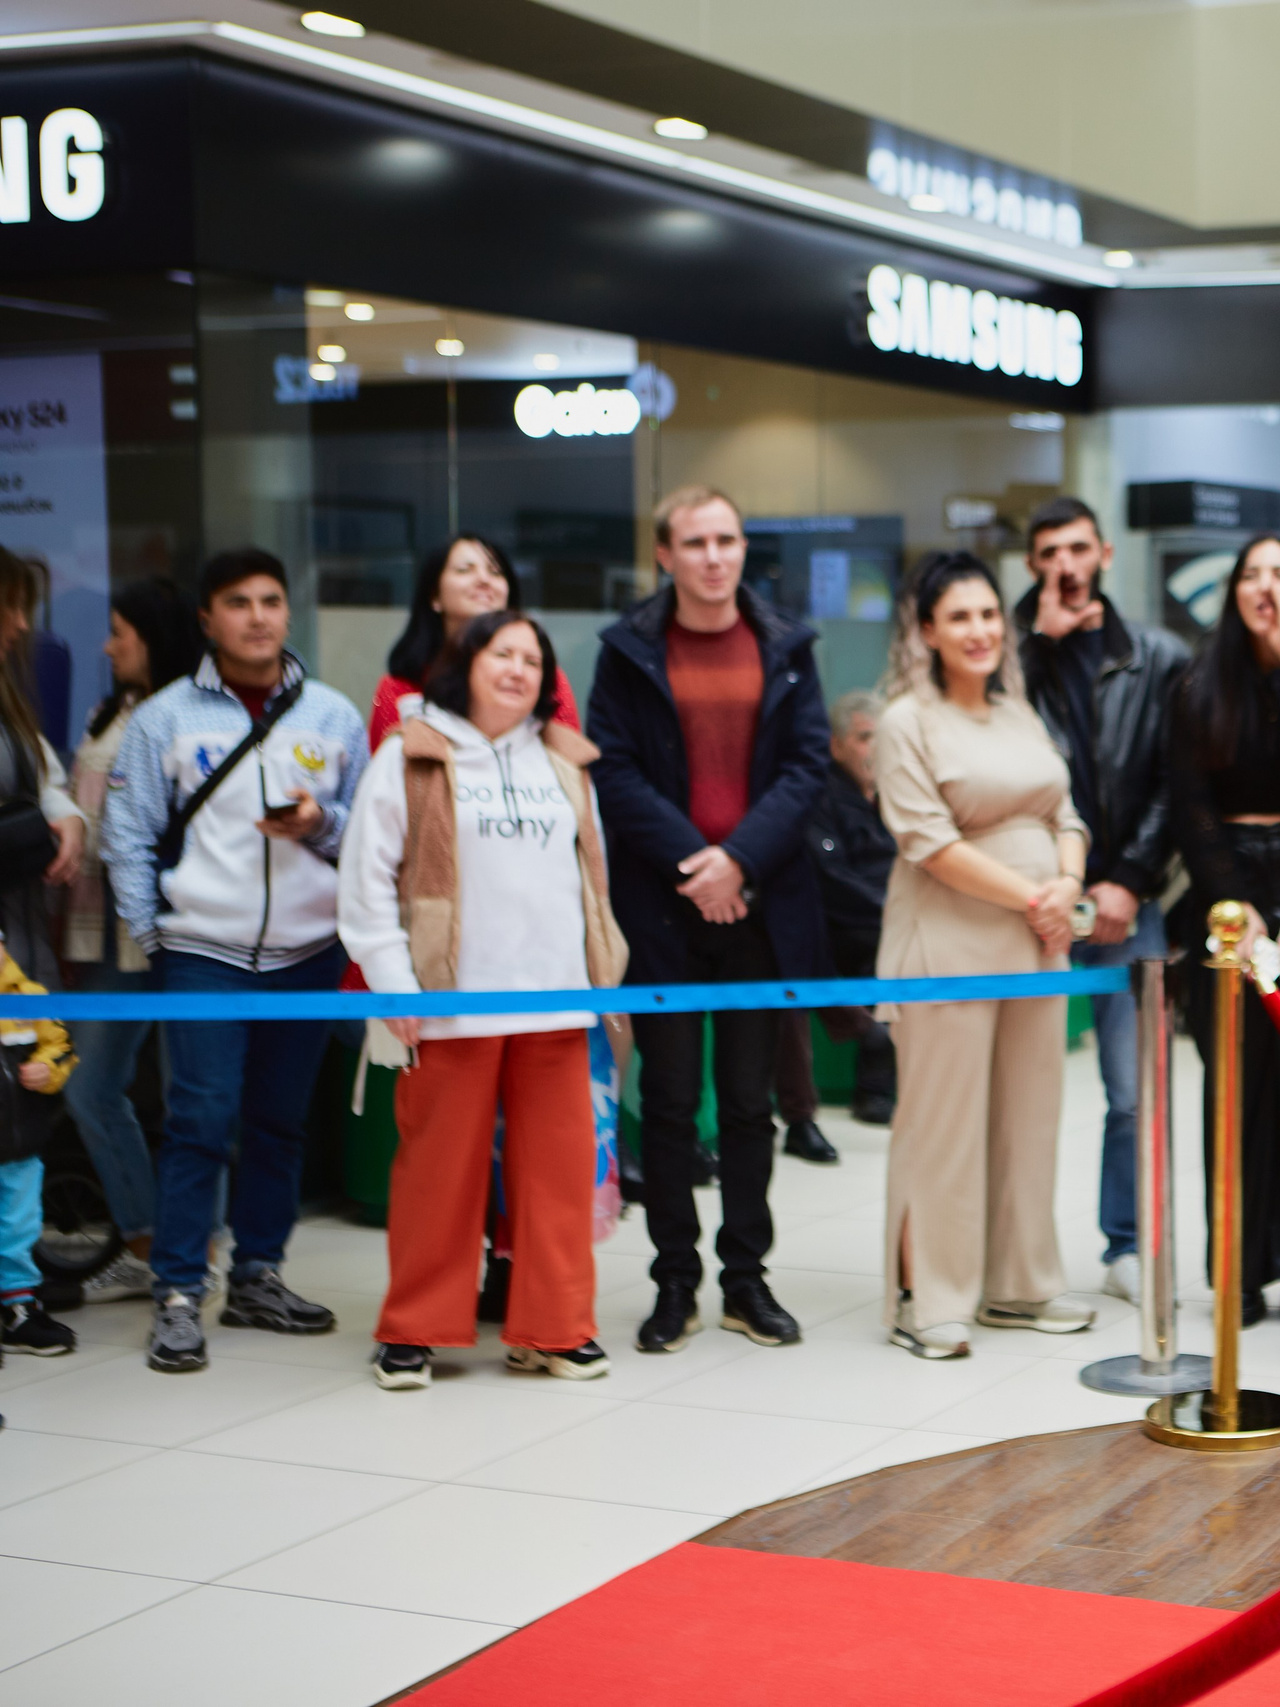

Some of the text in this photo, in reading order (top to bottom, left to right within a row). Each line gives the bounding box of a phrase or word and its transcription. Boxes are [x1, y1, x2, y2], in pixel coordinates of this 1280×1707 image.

[867, 264, 1083, 387] SAMSUNG
[456, 784, 566, 804] oo muc
[478, 809, 558, 851] irony
